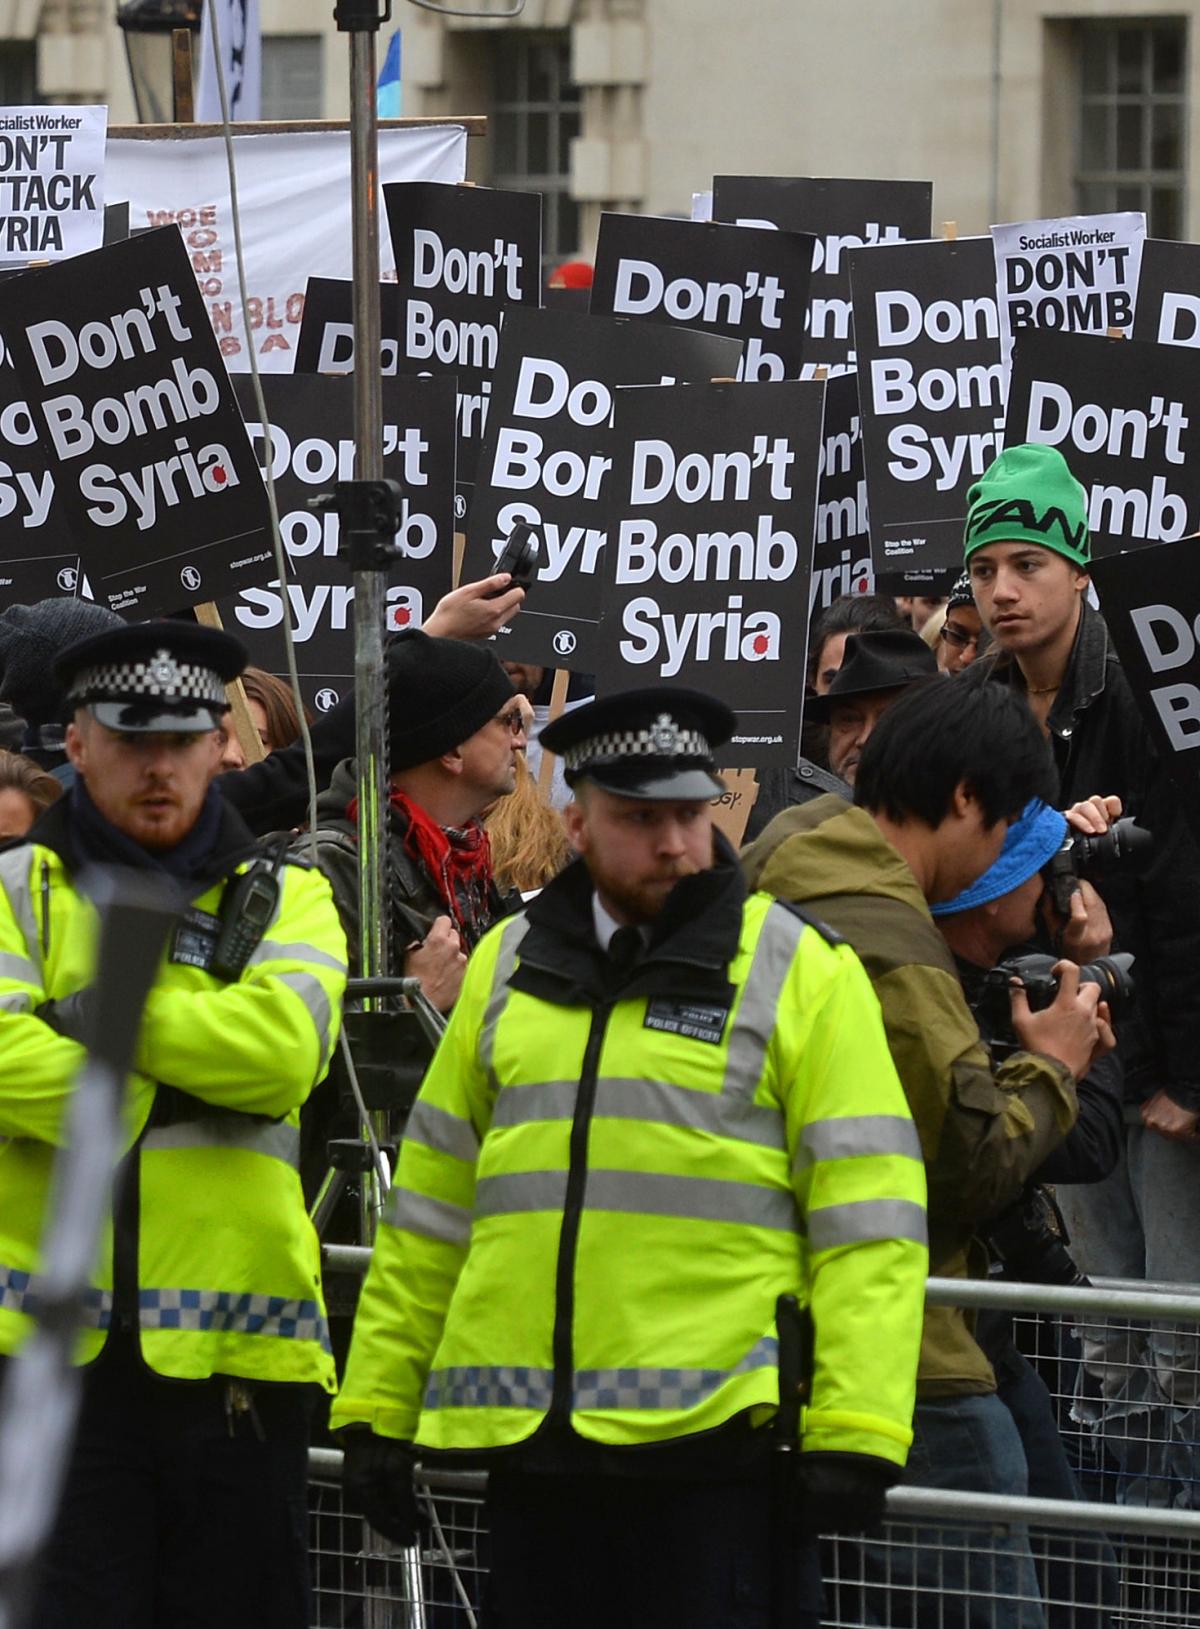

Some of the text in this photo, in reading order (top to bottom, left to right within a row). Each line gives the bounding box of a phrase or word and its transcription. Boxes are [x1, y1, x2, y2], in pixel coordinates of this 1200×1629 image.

[36, 115, 82, 131] Worker
[413, 228, 523, 301] Don't
[1005, 247, 1130, 295] DON'T
[1018, 230, 1115, 251] Socialist Worker
[613, 258, 785, 329] Don't
[1008, 291, 1134, 331] BOMB
[25, 284, 193, 387] Don't
[41, 356, 220, 461] Bomb
[1025, 380, 1189, 466] Don't
[79, 437, 241, 531] Syria
[630, 435, 795, 506] Don't
[615, 515, 799, 585] Bomb
[619, 595, 782, 678] Syria
[731, 735, 783, 745] stopwar.org.uk
